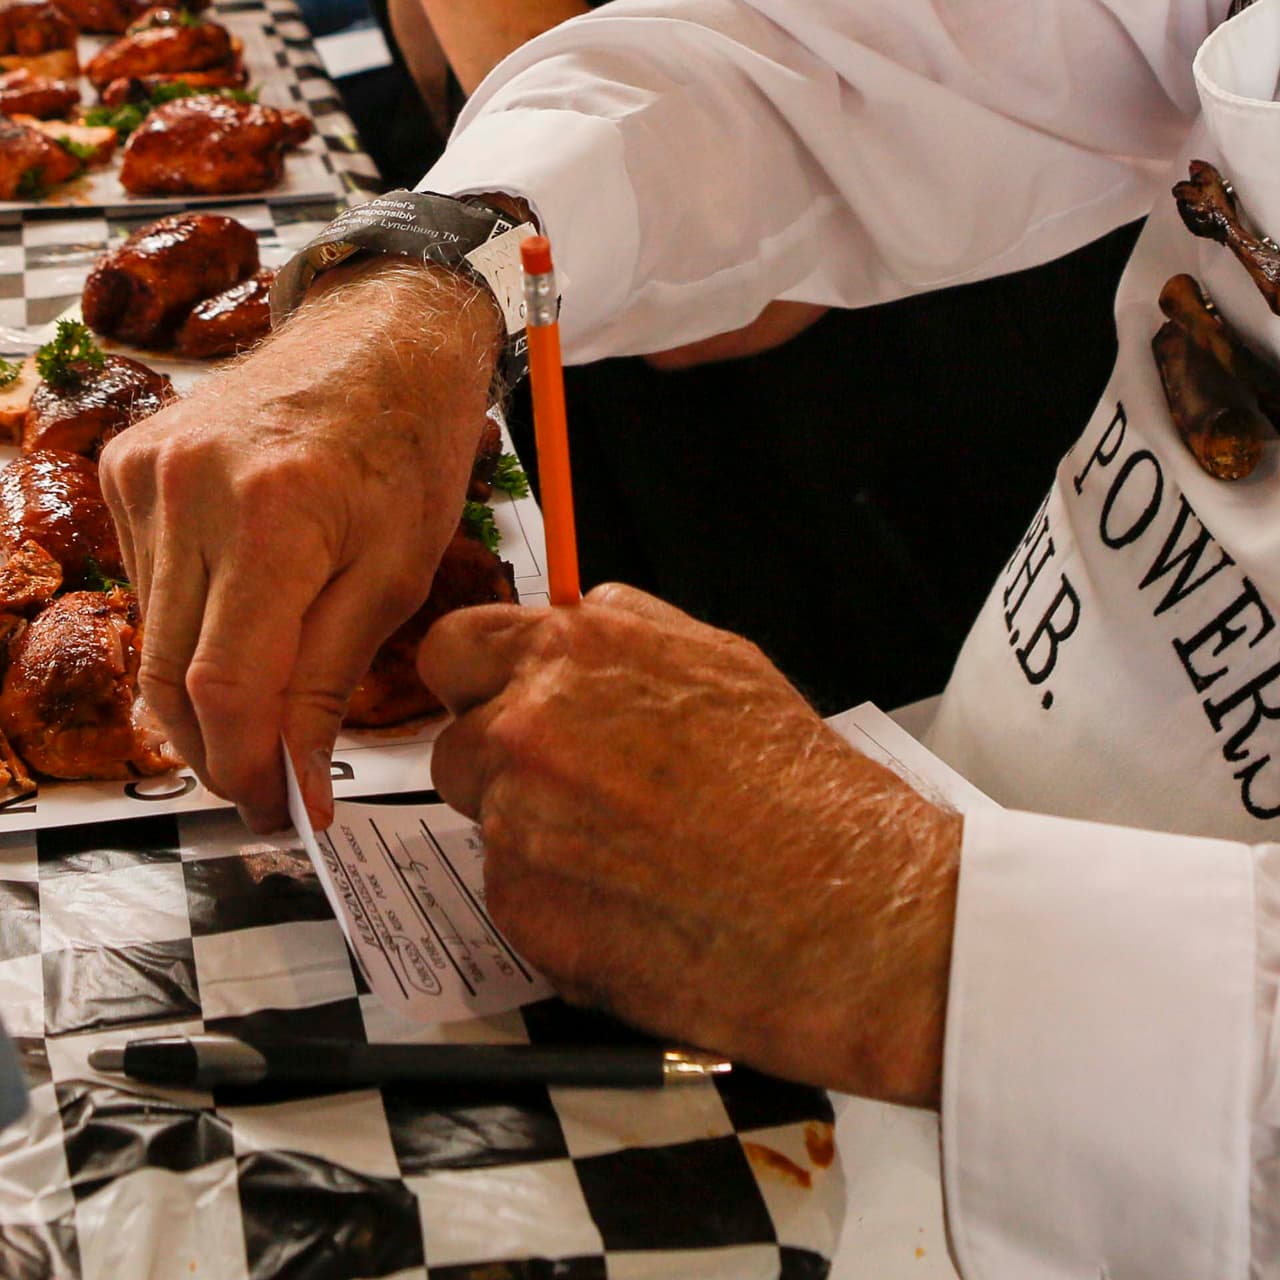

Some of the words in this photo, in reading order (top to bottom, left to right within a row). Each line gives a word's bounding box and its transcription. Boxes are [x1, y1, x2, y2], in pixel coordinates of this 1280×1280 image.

[371, 199, 416, 210] Daniel's
[354, 208, 417, 221] responsibly
[380, 219, 439, 238] Lynchburg
[442, 231, 460, 242] TN
